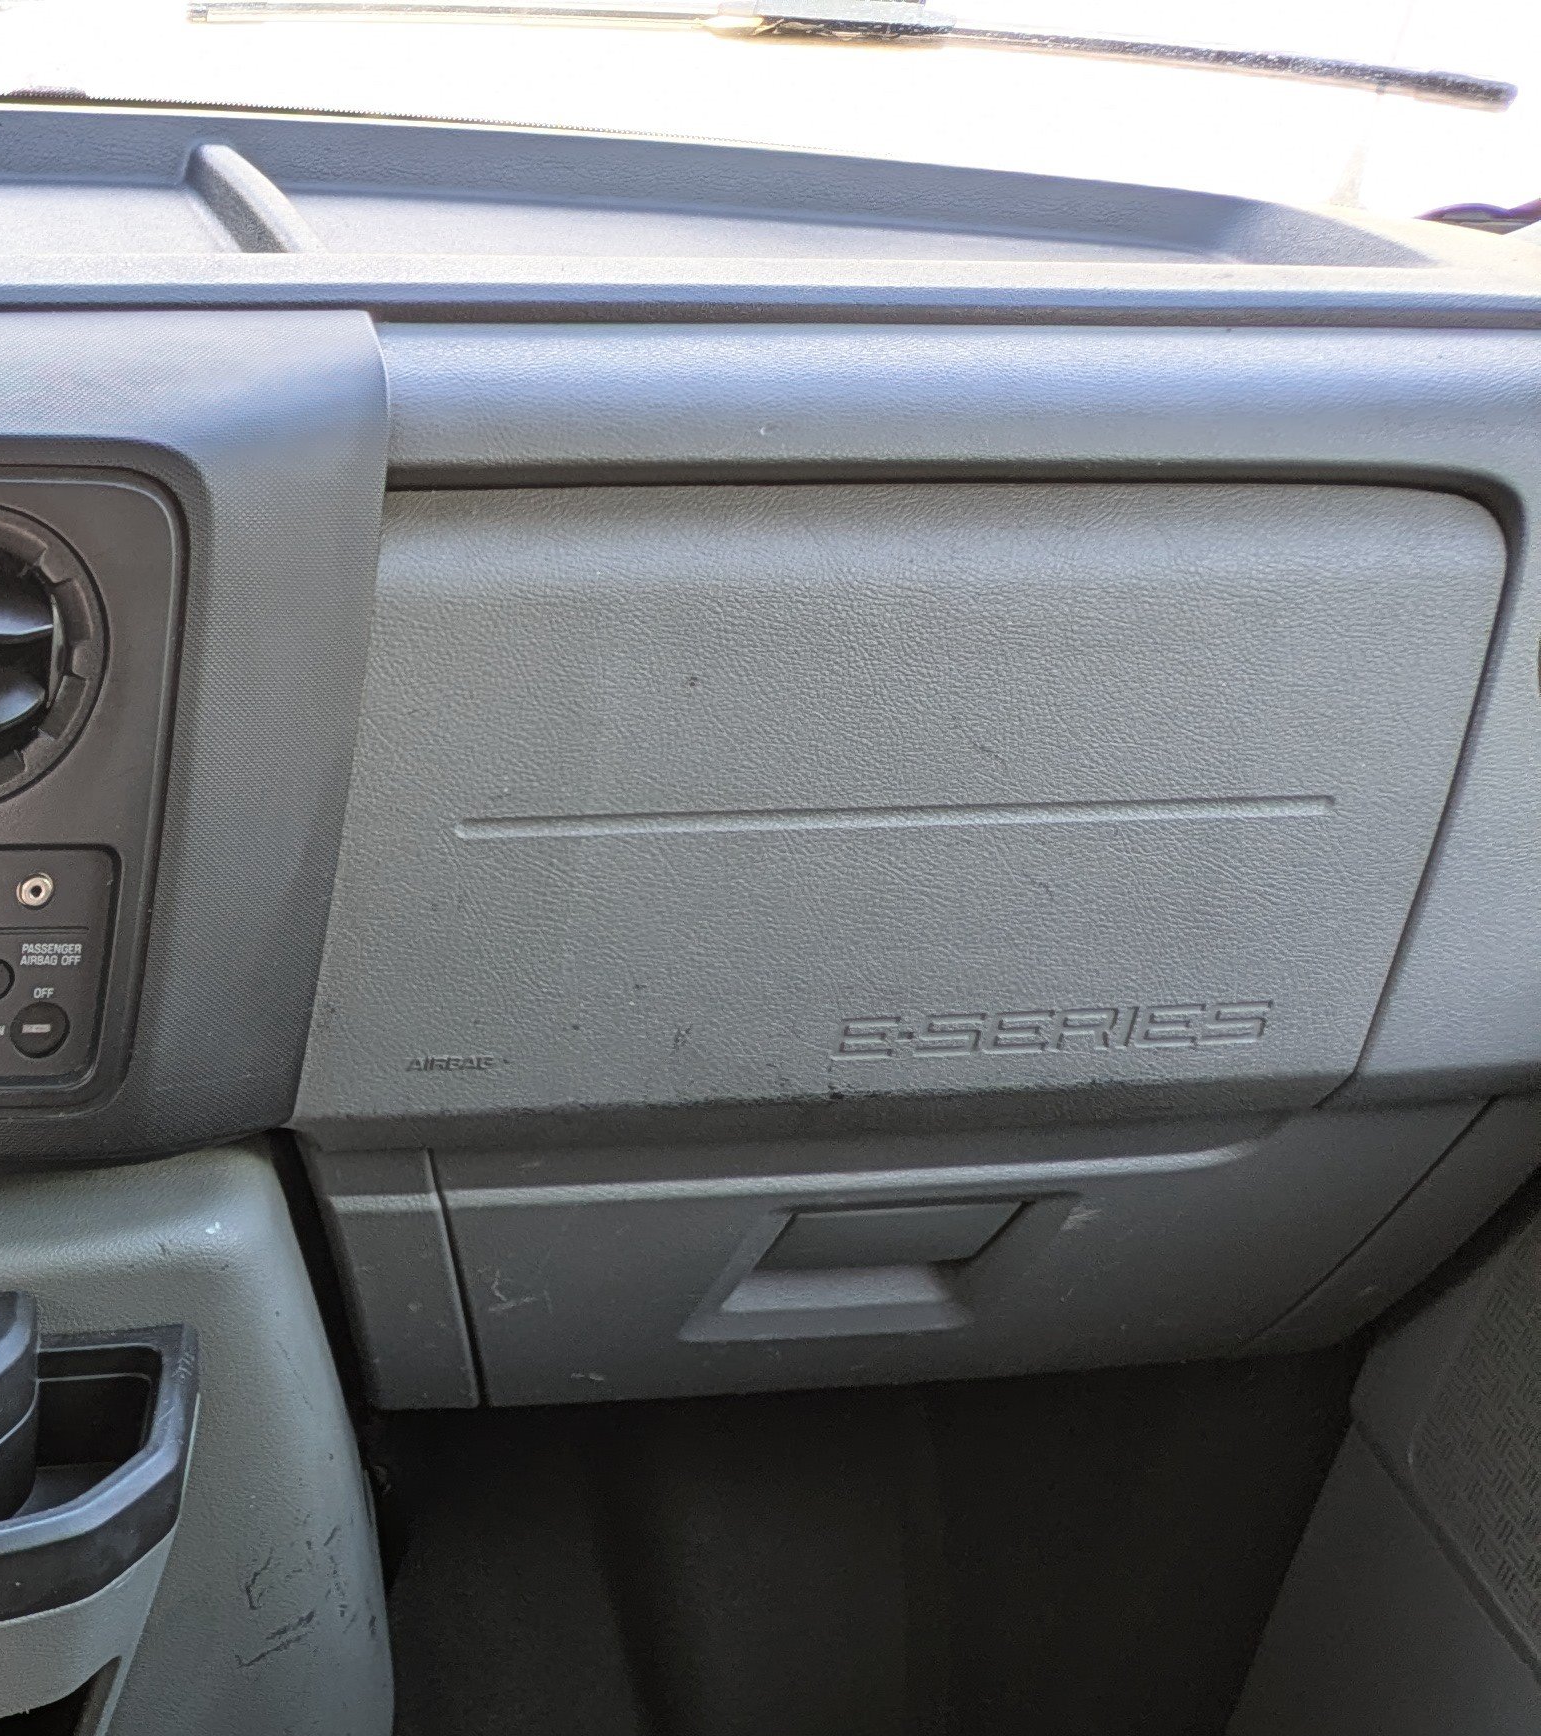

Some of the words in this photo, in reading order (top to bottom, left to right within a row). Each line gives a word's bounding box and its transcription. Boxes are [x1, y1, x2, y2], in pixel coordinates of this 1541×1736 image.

[21, 943, 83, 955] PASSENGER
[20, 954, 58, 966] AIRBAG
[60, 955, 82, 966] OFF
[33, 987, 55, 999] OFF
[828, 1000, 1274, 1062] E-SERIES
